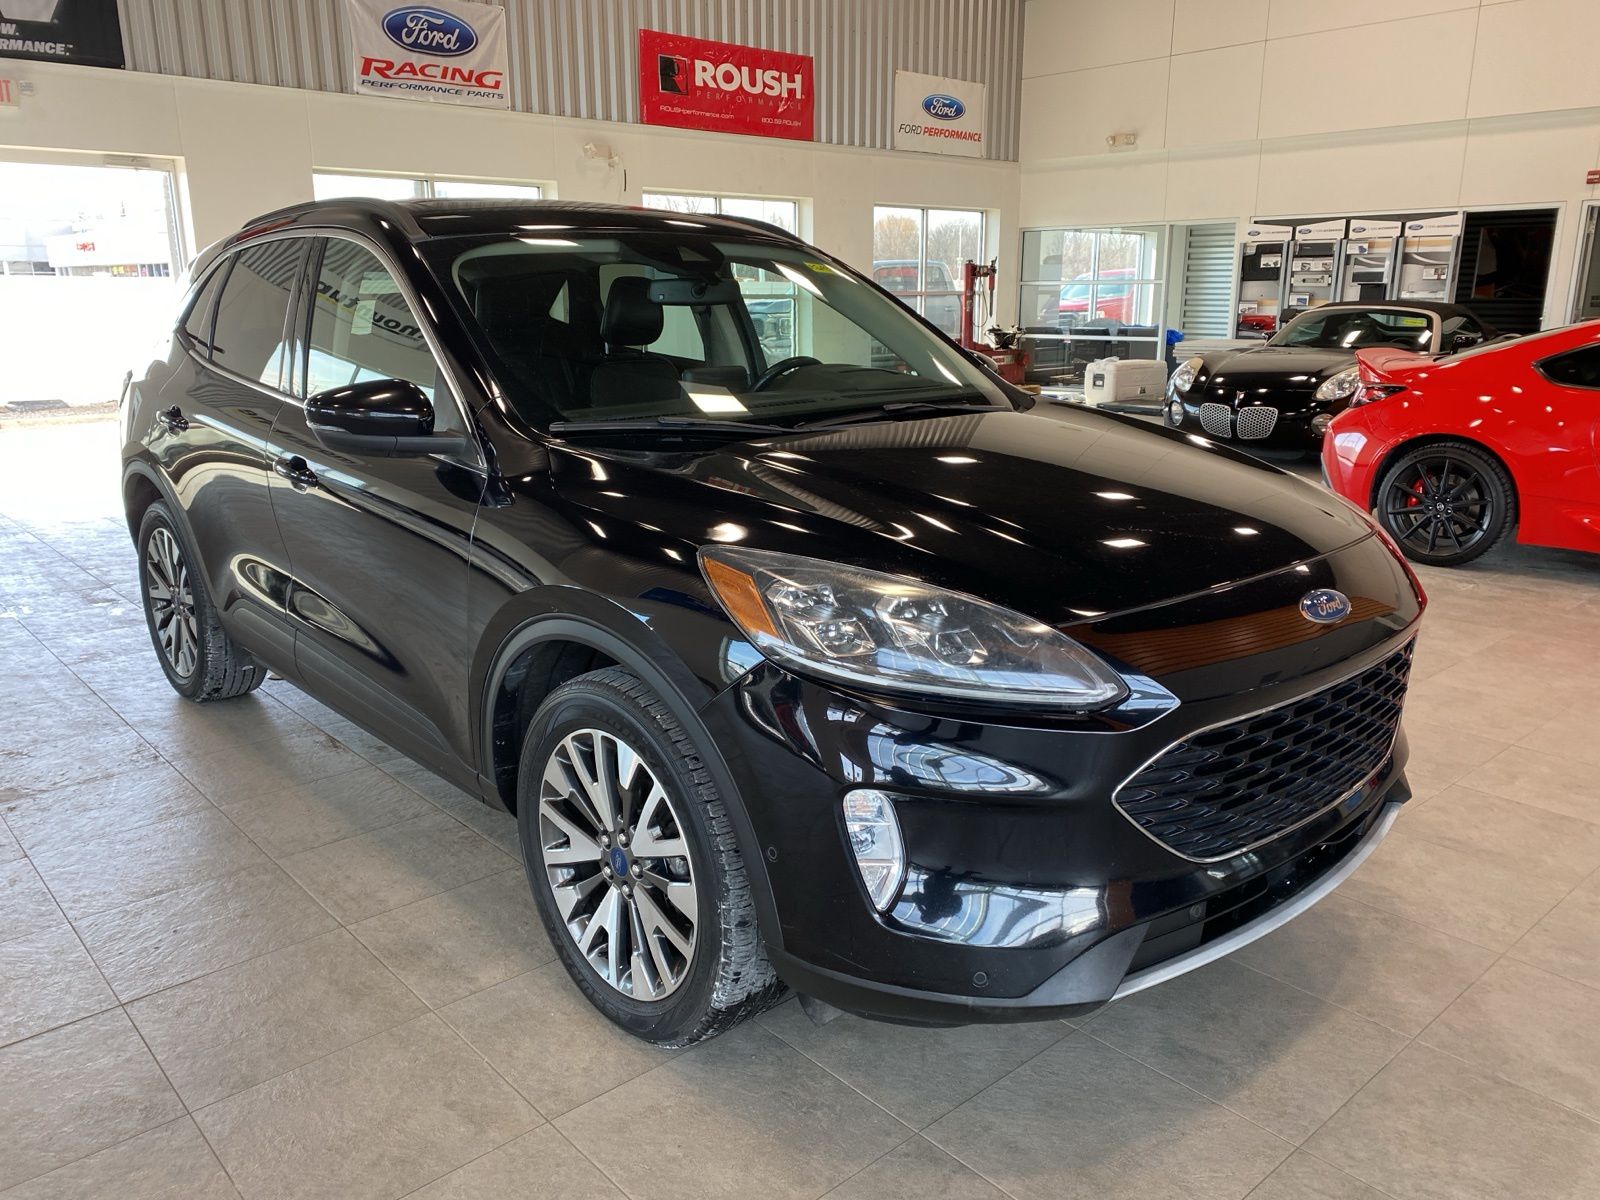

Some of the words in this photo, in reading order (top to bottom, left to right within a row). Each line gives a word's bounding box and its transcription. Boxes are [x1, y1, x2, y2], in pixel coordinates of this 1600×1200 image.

[401, 13, 460, 50] Ford
[360, 55, 503, 90] RACING
[694, 59, 803, 99] ROUSH
[361, 79, 463, 96] PERFORMANCE
[467, 90, 504, 100] PARTS
[930, 97, 958, 117] Ford
[898, 123, 922, 135] FORD
[923, 126, 982, 142] PERFORMANCE
